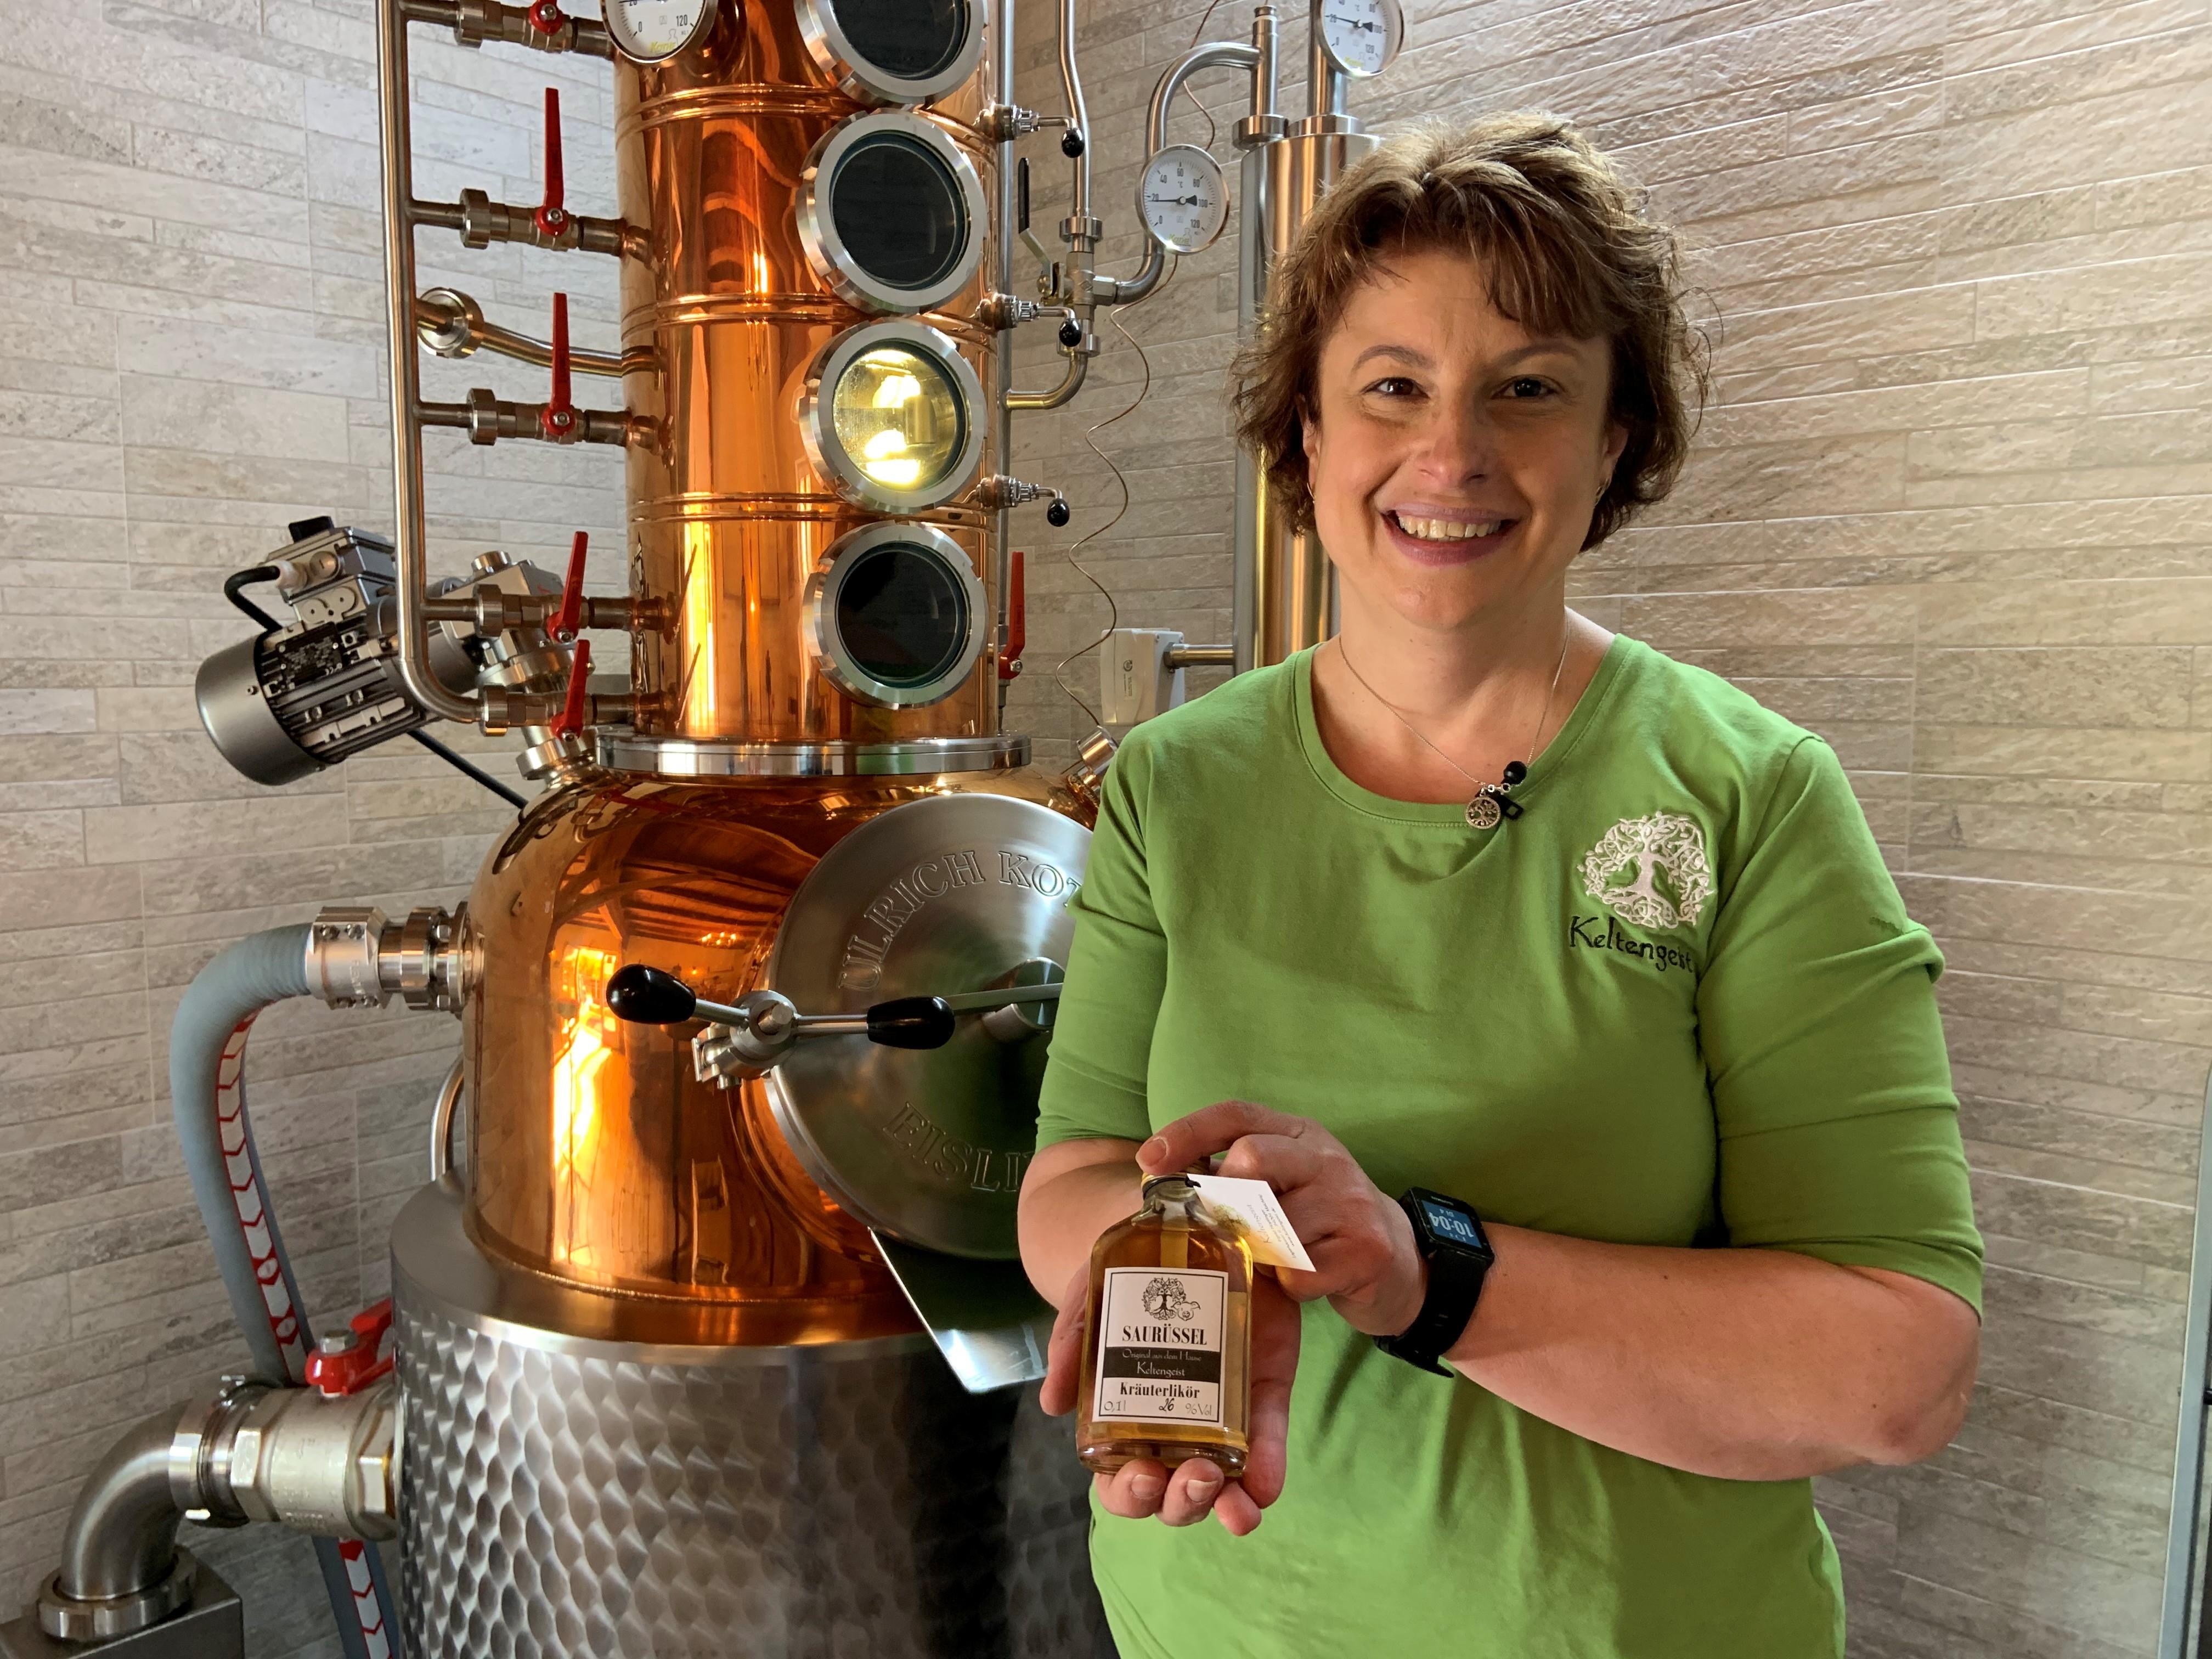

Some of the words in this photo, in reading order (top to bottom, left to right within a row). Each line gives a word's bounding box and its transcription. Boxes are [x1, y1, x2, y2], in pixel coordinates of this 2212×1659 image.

[638, 21, 642, 32] 0
[676, 14, 687, 26] 120
[1160, 174, 1167, 184] 40
[1152, 193, 1159, 202] 20
[1198, 199, 1208, 208] 100
[1159, 216, 1163, 224] 0
[1190, 219, 1200, 228] 120
[838, 850, 986, 992] ULRICH
[882, 1101, 1035, 1192] EISLI
[1429, 1212, 1475, 1238] 10:04
[1122, 1323, 1207, 1345] SAURÜSSEL
[1122, 1348, 1150, 1360] Original
[1164, 1350, 1178, 1360] dem
[1180, 1351, 1202, 1362] Hause
[1137, 1361, 1186, 1378] Keltengeist
[1120, 1382, 1200, 1398] Kräuterlikör
[1159, 1398, 1175, 1412] 26
